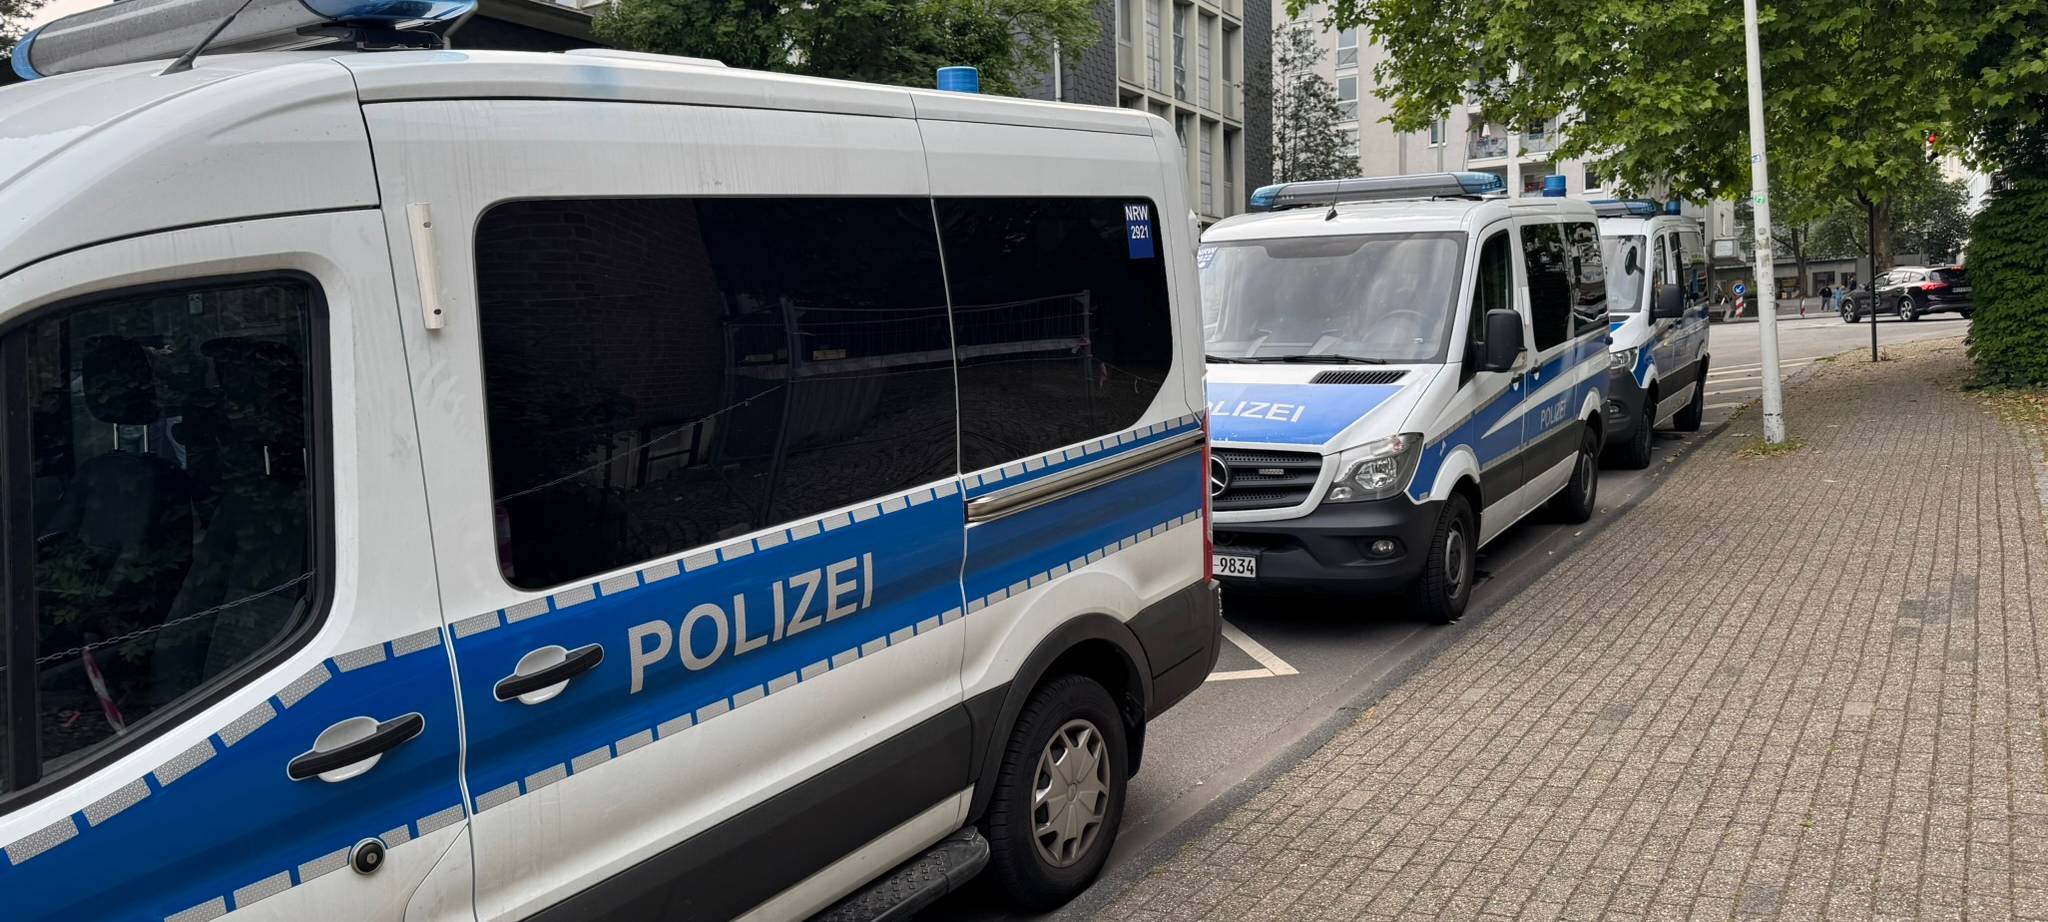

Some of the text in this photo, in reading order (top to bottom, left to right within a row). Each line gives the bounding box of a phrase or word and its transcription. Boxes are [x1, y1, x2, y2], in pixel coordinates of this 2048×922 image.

[1125, 205, 1148, 221] NRW
[1131, 225, 1149, 239] 2921
[628, 552, 872, 694] POLIZEI
